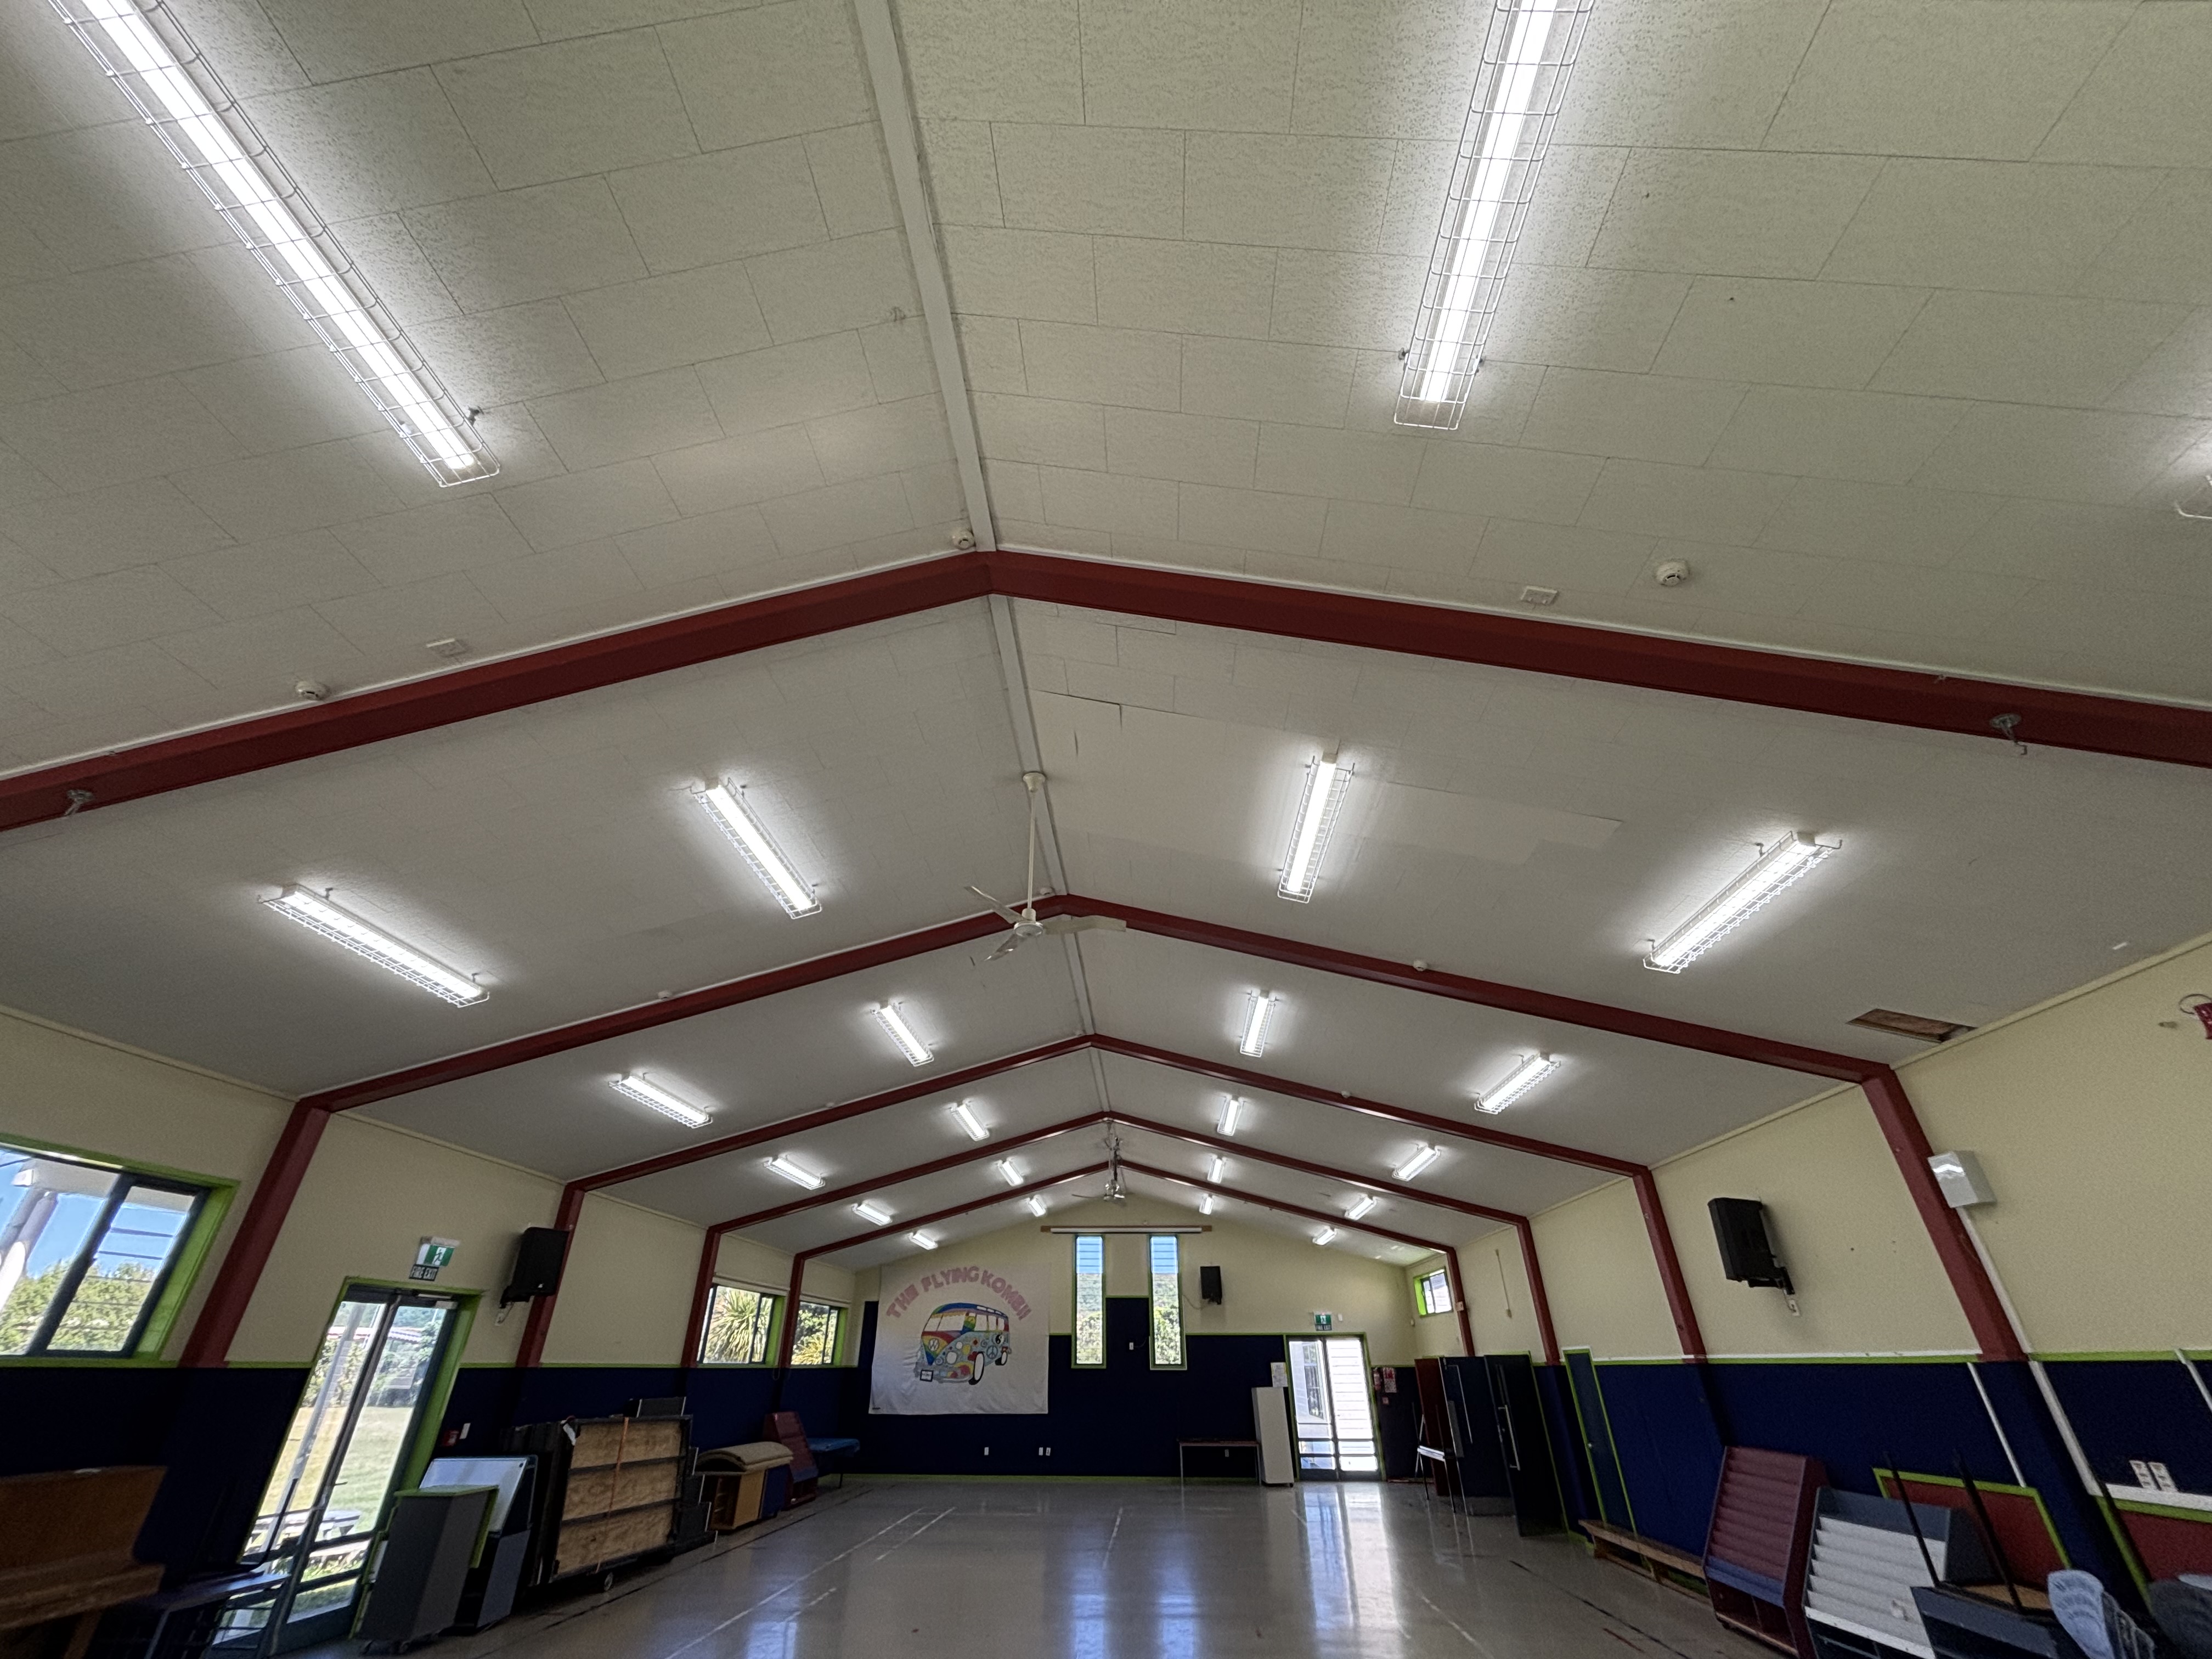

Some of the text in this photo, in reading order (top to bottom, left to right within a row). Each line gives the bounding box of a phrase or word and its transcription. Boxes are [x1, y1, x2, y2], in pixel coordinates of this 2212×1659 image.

[410, 1266, 437, 1280] FIRE EXIT
[886, 1284, 919, 1318] THE
[921, 1266, 979, 1292] FLYING
